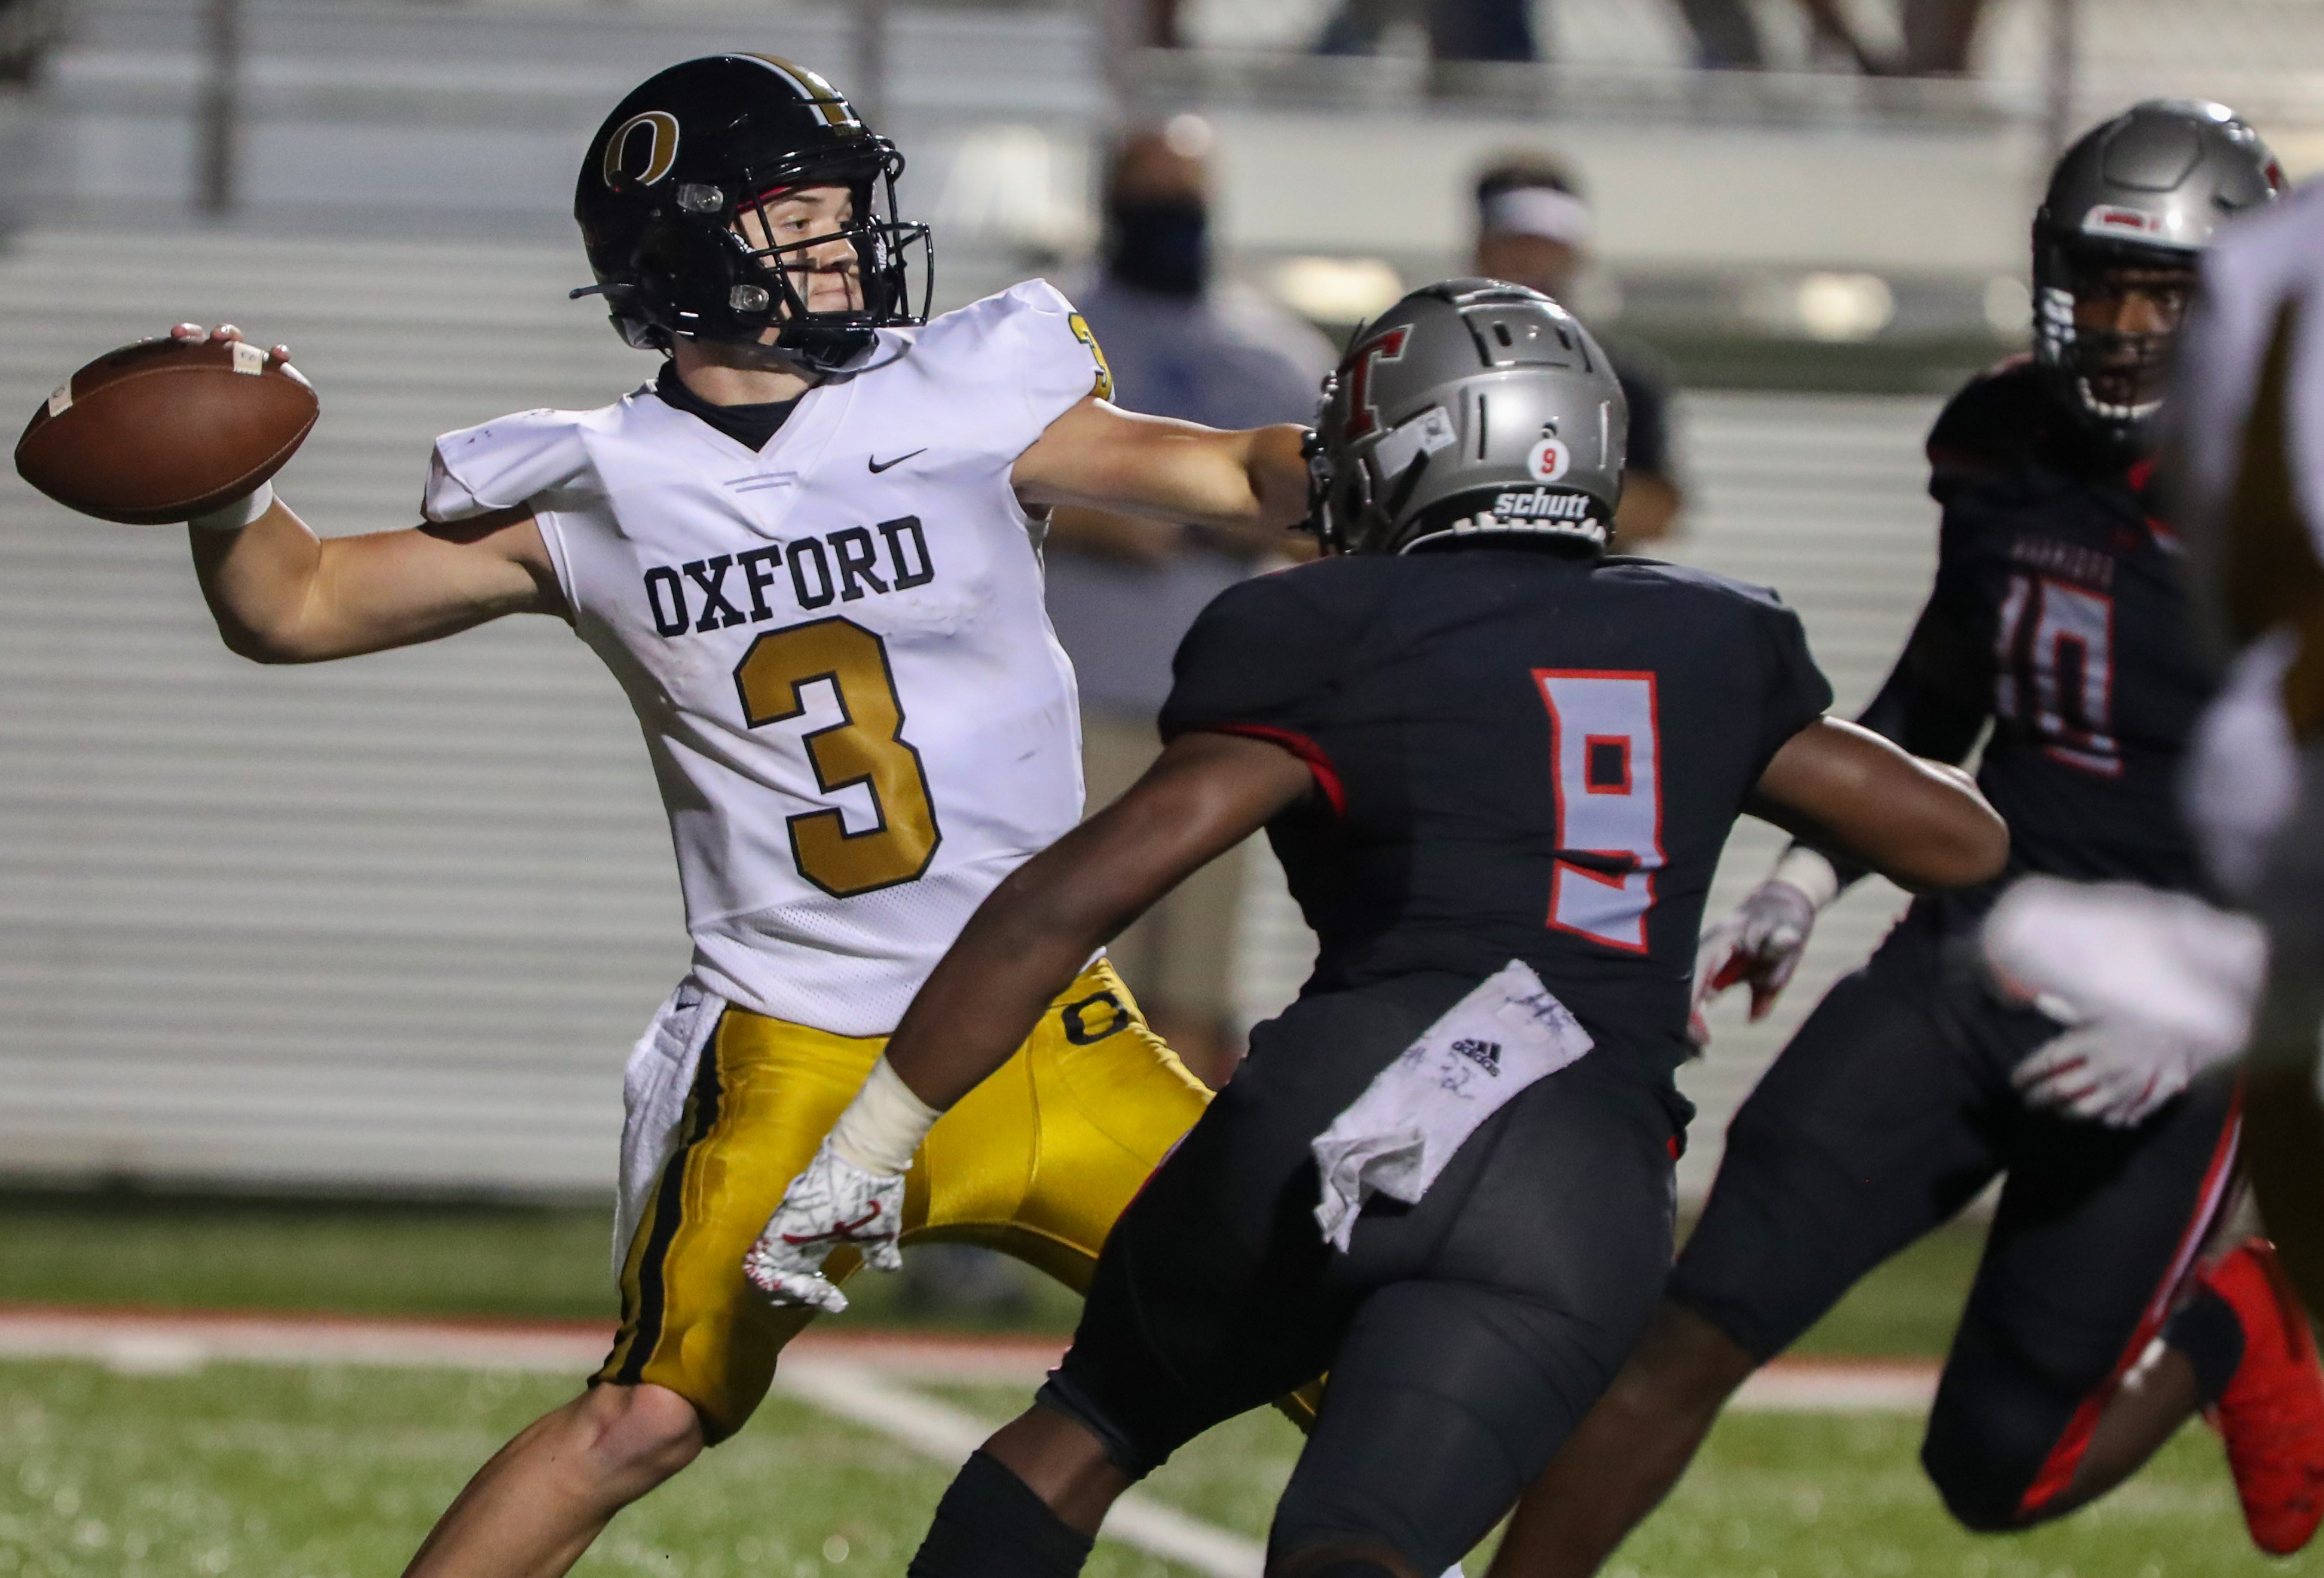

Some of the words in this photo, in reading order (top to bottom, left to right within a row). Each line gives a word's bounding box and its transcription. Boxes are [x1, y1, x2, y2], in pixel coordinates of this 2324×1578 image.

[604, 110, 680, 187] O
[1068, 311, 1113, 402] 3
[1339, 323, 1415, 446] T
[1494, 487, 1591, 519] schutt
[1540, 447, 1558, 475] 9
[643, 515, 935, 638] OXFORD
[732, 614, 943, 900] 3
[1530, 668, 1669, 955] 9
[1450, 1040, 1502, 1078] adidas
